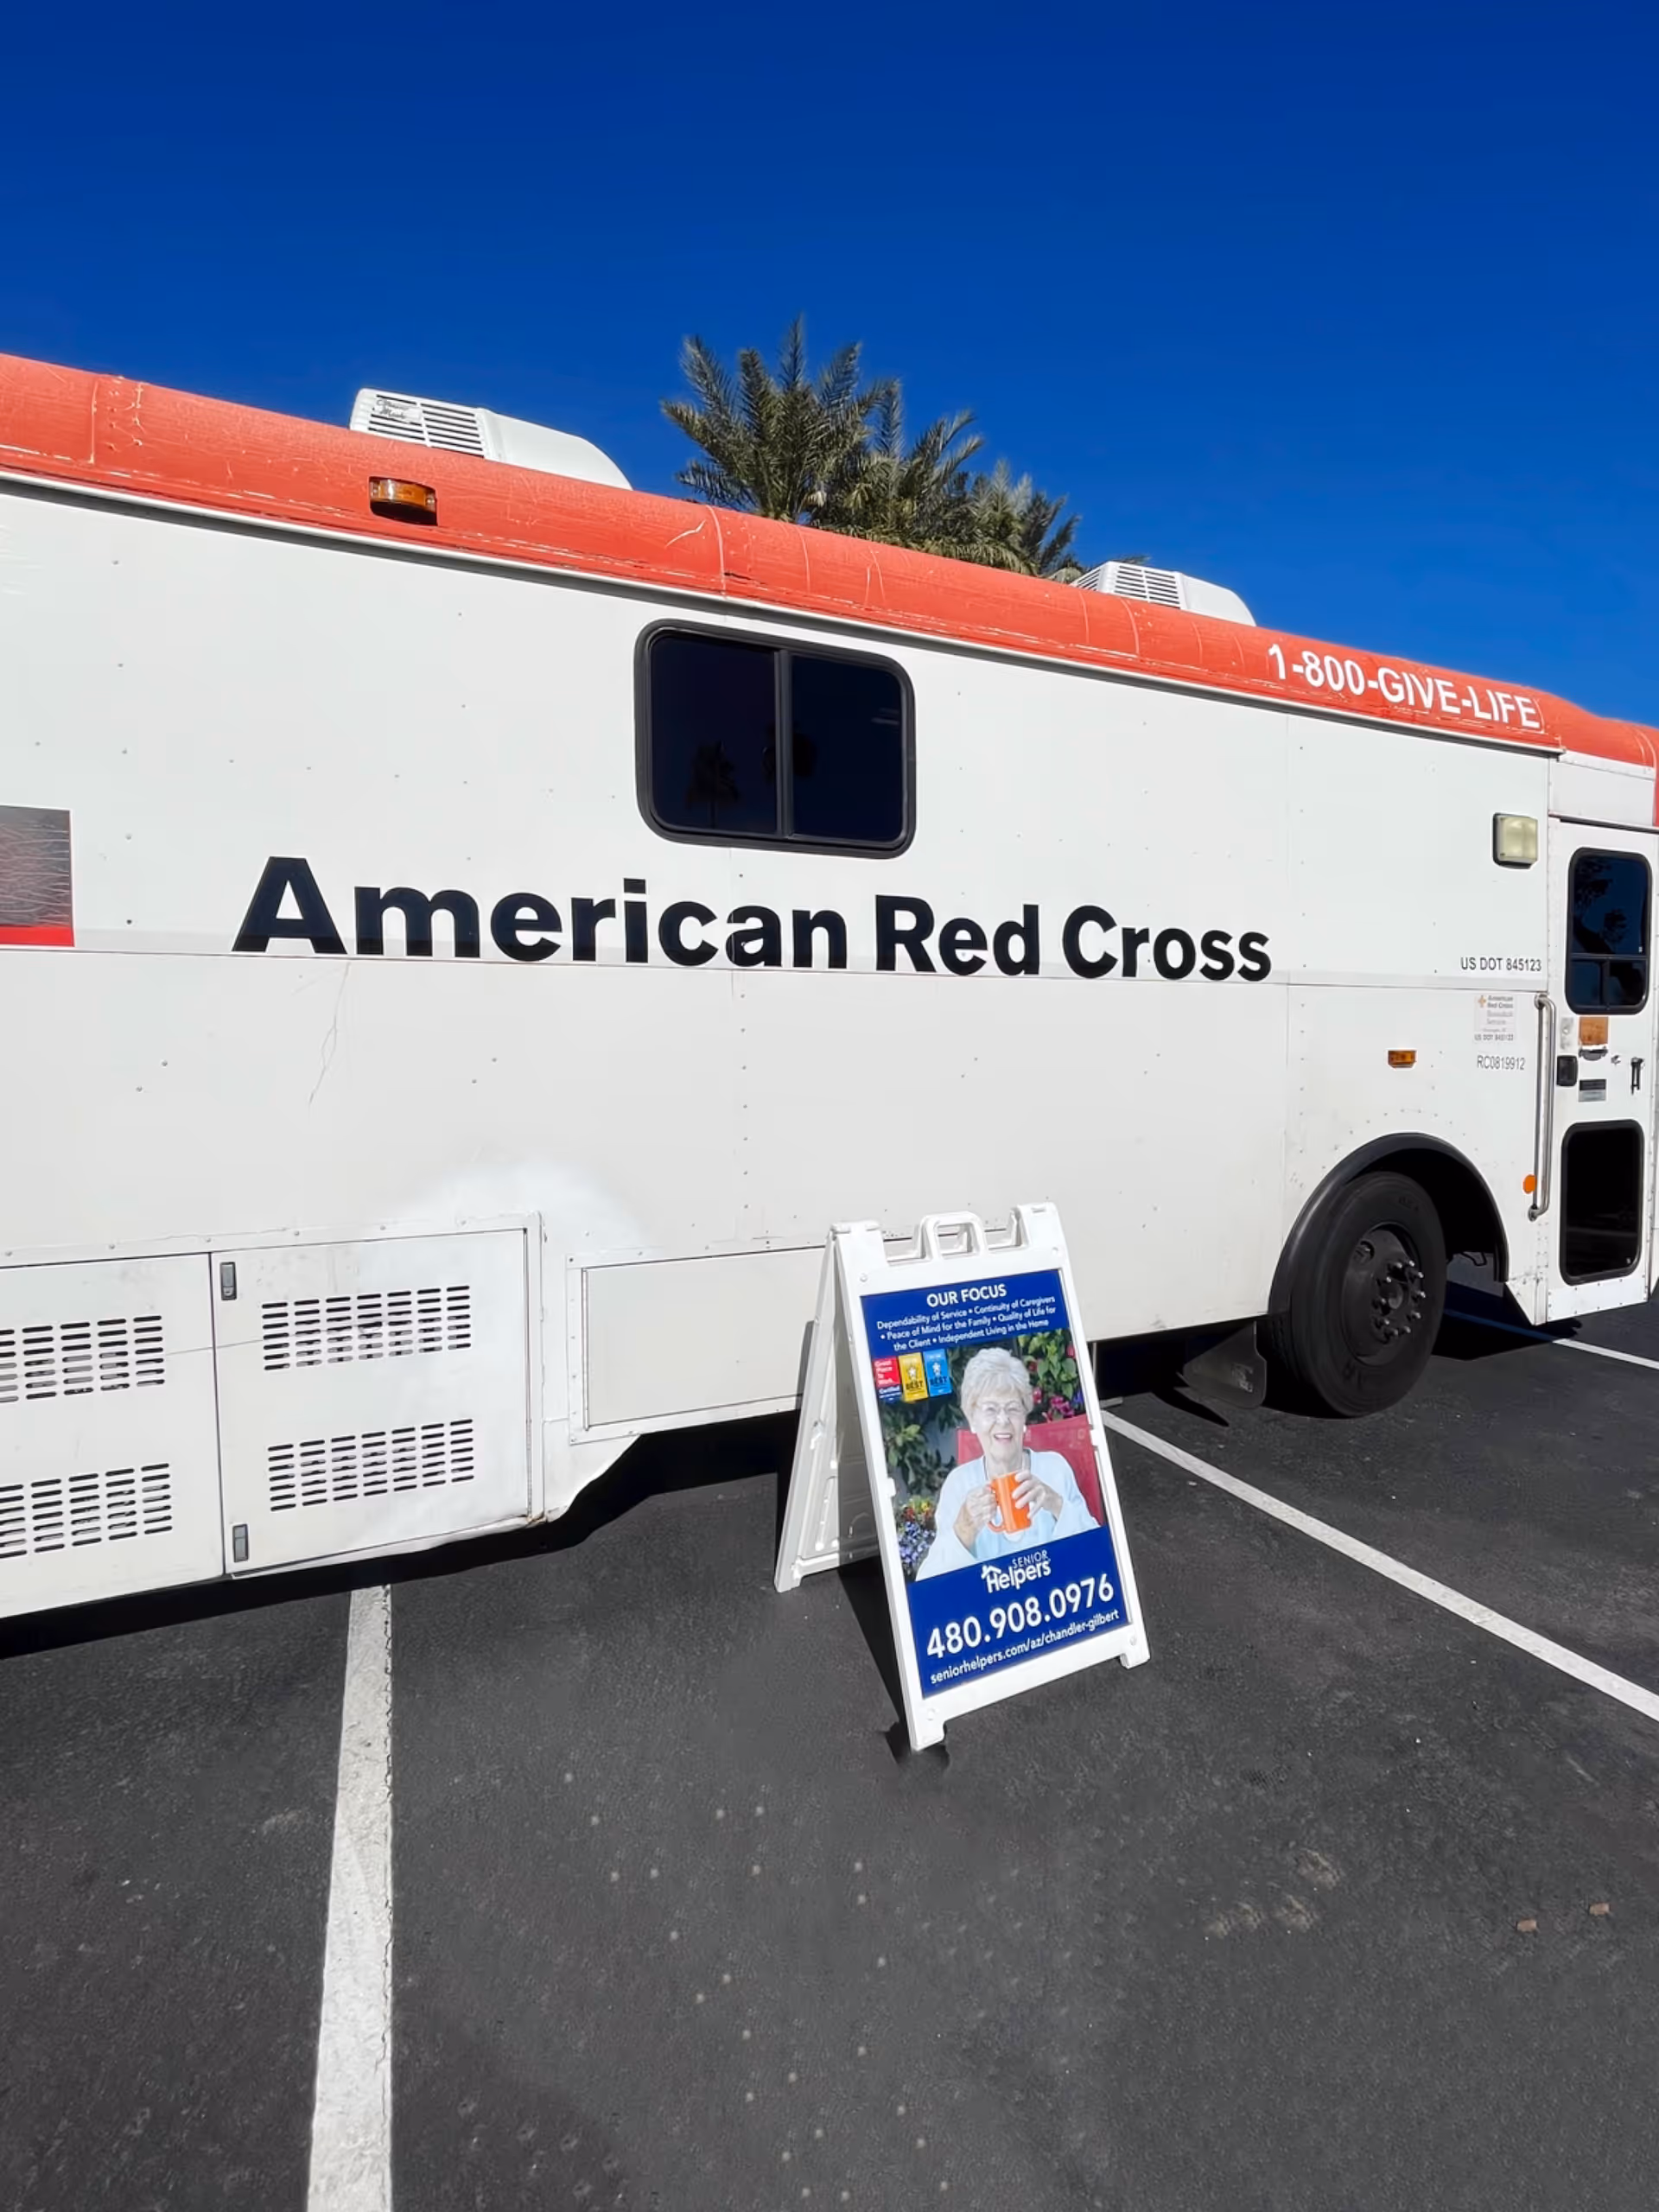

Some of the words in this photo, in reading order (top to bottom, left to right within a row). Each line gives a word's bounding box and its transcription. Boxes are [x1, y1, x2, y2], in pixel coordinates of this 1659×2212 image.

[1268, 644, 1540, 728] 1-800-GIVE-LIFE
[232, 856, 847, 969] American
[875, 894, 1040, 976] Red
[1062, 905, 1272, 982] Cross
[1460, 957, 1477, 970] US
[1480, 957, 1503, 970] DOT
[1506, 957, 1541, 971] 845123
[1477, 1055, 1525, 1071] RC0819912
[926, 1291, 959, 1308] OUR
[961, 1283, 1007, 1303] FOCUS
[876, 1313, 931, 1330] Dependability
[931, 1311, 939, 1321] of
[940, 1309, 968, 1320] Service
[974, 1302, 1010, 1315] Continuity
[1011, 1299, 1019, 1309] of
[1020, 1296, 1056, 1308] Caregivers
[887, 1330, 911, 1341] Peace
[912, 1325, 920, 1337] of
[921, 1324, 941, 1335] Mind
[942, 1322, 952, 1332] for
[954, 1319, 967, 1329] the
[968, 1315, 991, 1327] Family
[998, 1311, 1023, 1323] Quality
[1024, 1308, 1032, 1318] of
[1032, 1306, 1046, 1317] Life
[1046, 1305, 1056, 1314] for
[893, 1341, 907, 1351] the
[908, 1338, 931, 1350] Client
[938, 1329, 985, 1344] Independent
[985, 1324, 1007, 1336] Living
[1007, 1323, 1015, 1332] in
[1015, 1321, 1027, 1332] the
[1027, 1319, 1049, 1329] Home
[1012, 1549, 1048, 1569] SENIOR
[983, 1560, 1051, 1593] Helpers
[926, 1573, 1114, 1659] 480.908.0976
[931, 1608, 1120, 1685] seniorhelpers.com/az/chandler-gilbert
